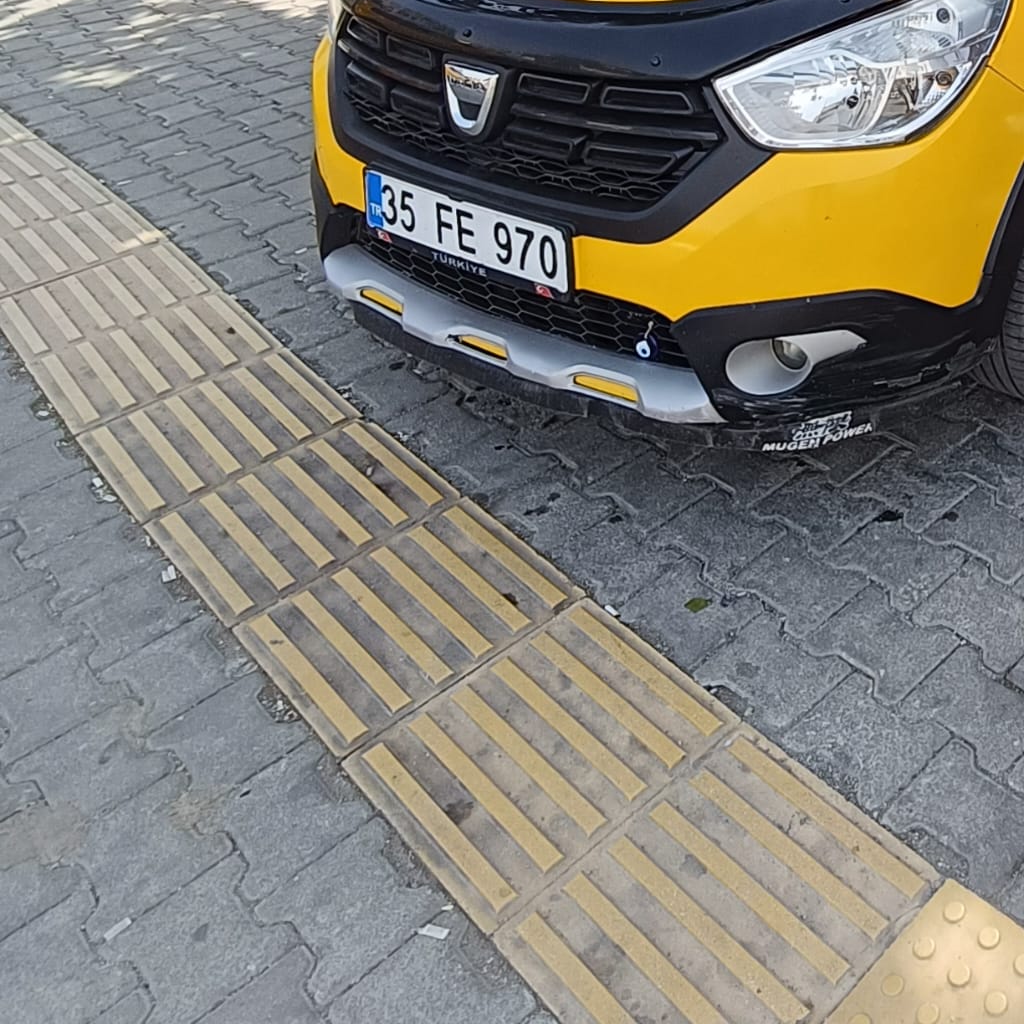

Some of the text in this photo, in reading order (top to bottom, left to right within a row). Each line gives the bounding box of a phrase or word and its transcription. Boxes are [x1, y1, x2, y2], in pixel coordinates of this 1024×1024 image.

[369, 202, 382, 216] TR
[381, 184, 558, 280] 35 FE 970
[762, 437, 820, 451] MUGEN
[822, 422, 872, 445] POWER
